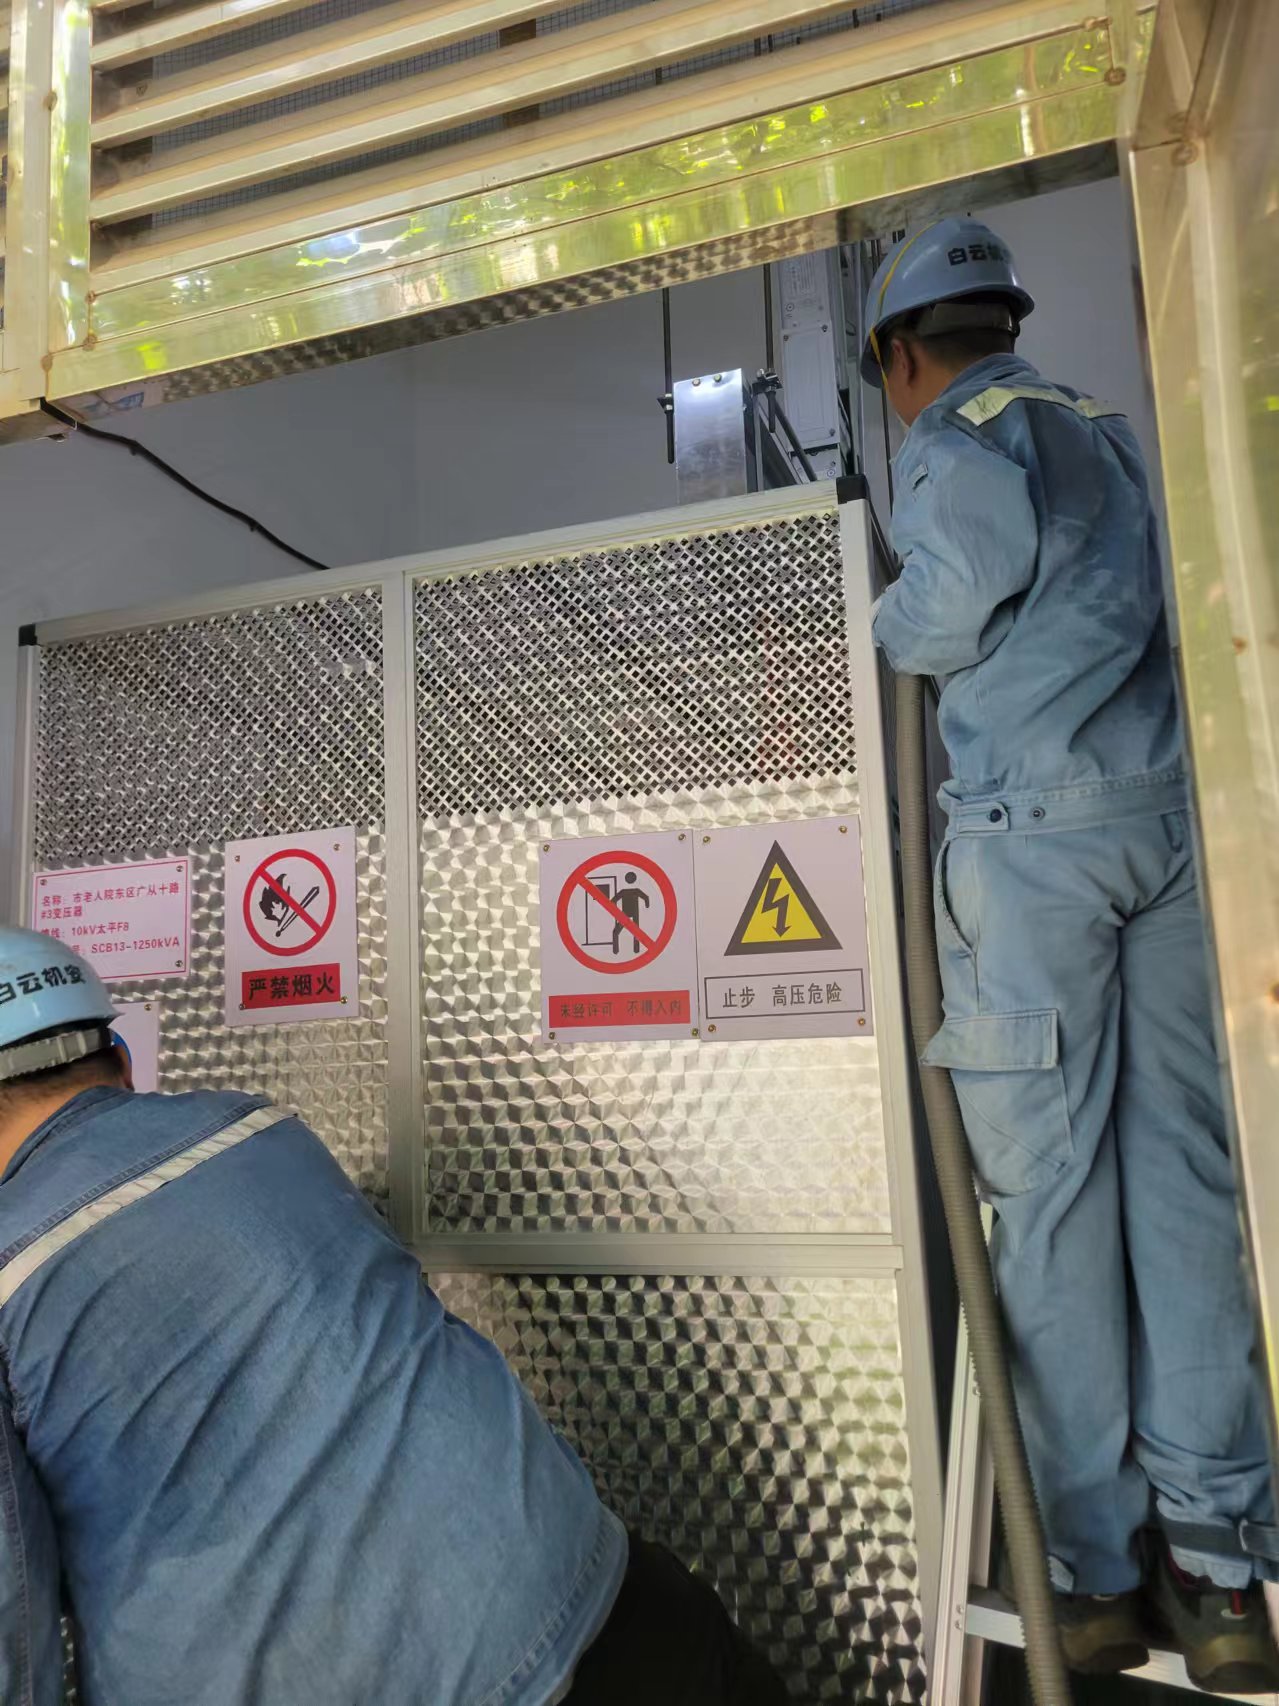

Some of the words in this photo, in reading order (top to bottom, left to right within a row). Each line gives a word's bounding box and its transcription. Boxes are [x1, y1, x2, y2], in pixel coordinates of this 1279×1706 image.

[248, 971, 335, 1001] 严禁烟火
[722, 986, 755, 1009] 止步
[771, 981, 843, 1007] 高压危险
[560, 1002, 613, 1019] 未经许可
[627, 999, 682, 1016] 不得入内
